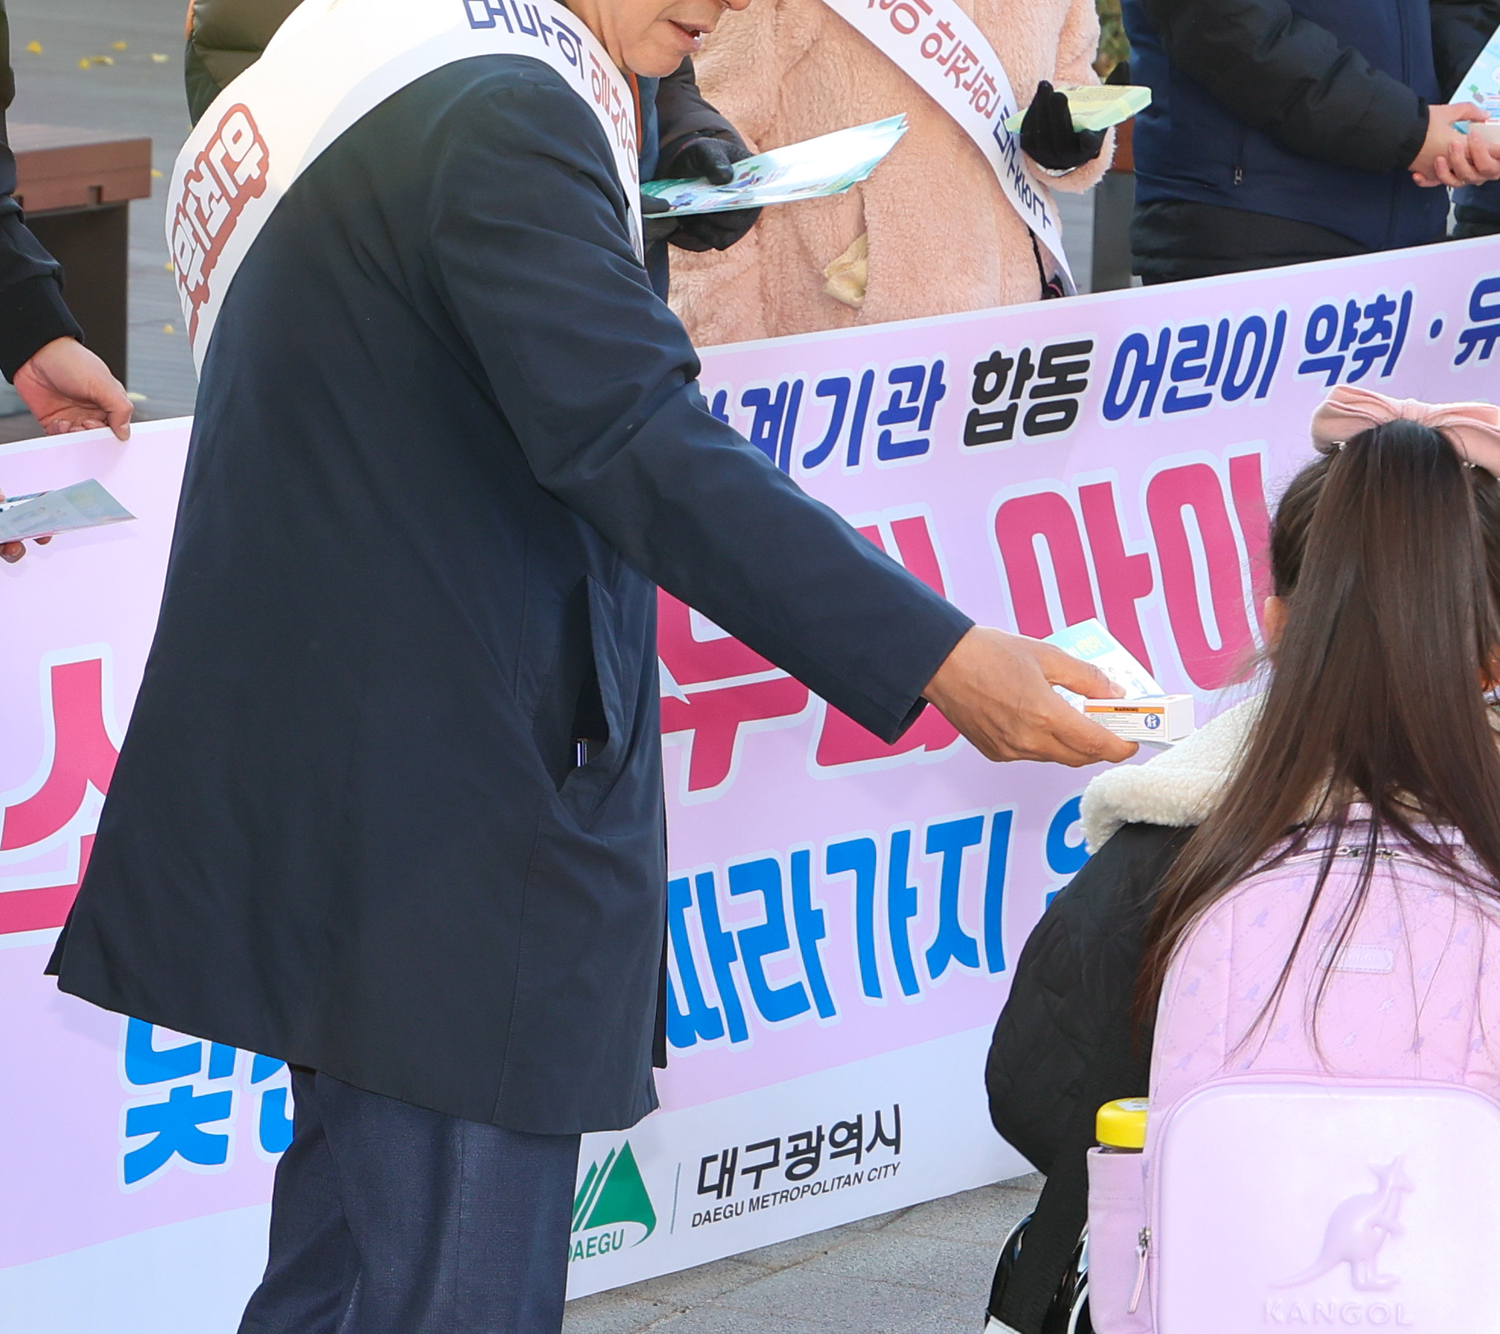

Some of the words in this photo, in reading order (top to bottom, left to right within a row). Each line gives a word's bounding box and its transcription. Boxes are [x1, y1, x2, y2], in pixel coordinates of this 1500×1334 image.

[919, 21, 1001, 120] 안전한
[701, 359, 946, 478] 계기관
[962, 339, 1094, 447] 합동
[1101, 310, 1288, 422] 어린이
[1298, 290, 1412, 388] 약취
[690, 1200, 746, 1229] DAEGU
[747, 1170, 865, 1213] METROPOLITAN
[866, 1162, 901, 1183] CITY
[695, 1103, 901, 1200] 대구광역시
[1263, 1301, 1414, 1327] KANGOL
